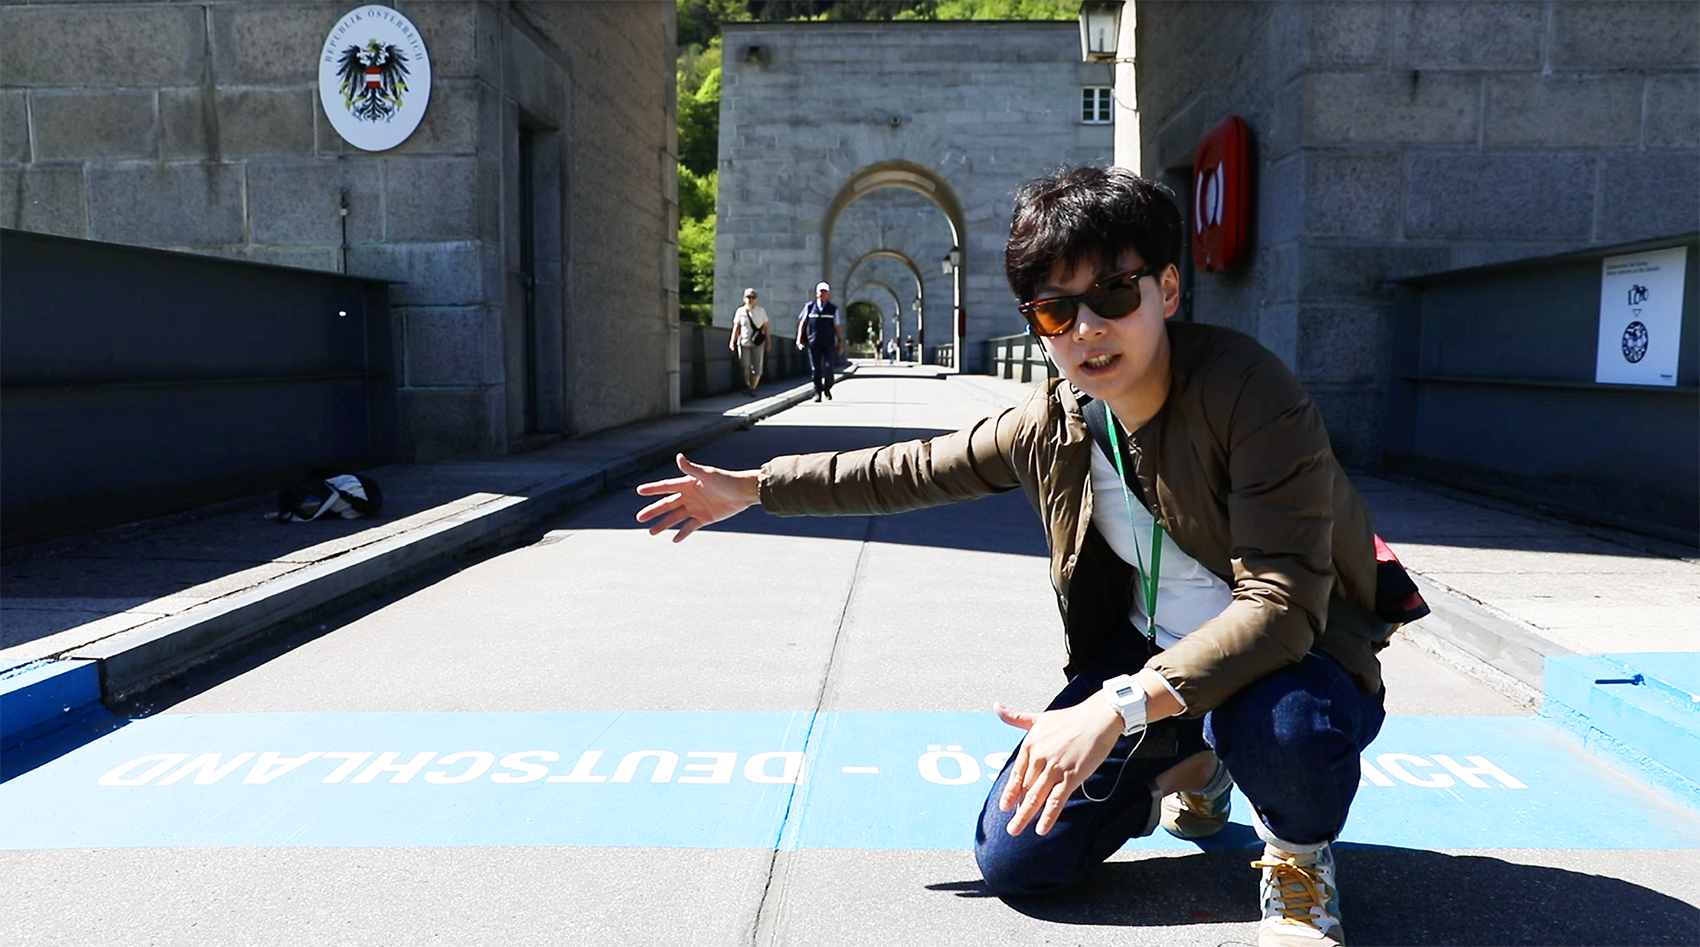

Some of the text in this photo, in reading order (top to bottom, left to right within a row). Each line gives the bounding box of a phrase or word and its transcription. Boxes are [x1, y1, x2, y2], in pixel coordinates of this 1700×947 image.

[325, 8, 424, 63] REPUBLIK ÖSTERREICH
[96, 750, 805, 787] DEUTSCHLAND
